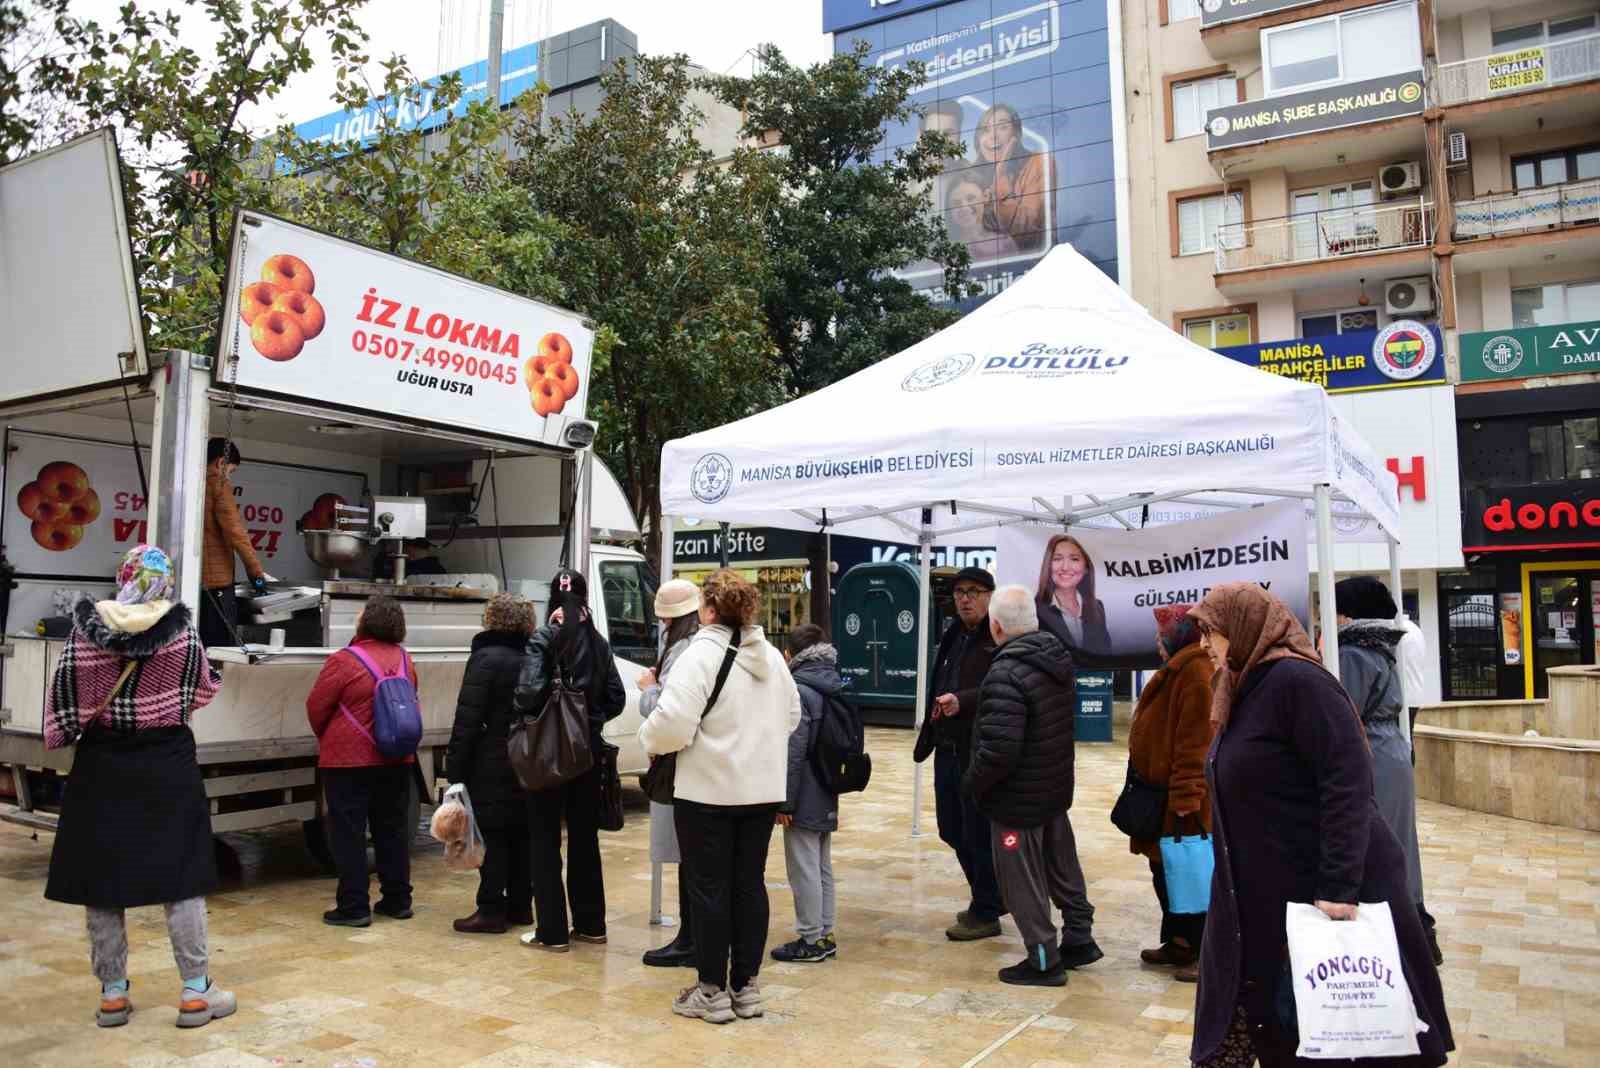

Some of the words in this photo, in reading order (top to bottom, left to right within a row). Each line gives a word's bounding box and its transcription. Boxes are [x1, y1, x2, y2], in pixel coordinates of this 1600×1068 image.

[998, 19, 1049, 58] iyisi
[1488, 58, 1542, 76] KIRALIK
[1233, 110, 1280, 131] MANİSA
[1283, 104, 1315, 125] ŞUBE
[1318, 88, 1396, 115] BAŞKANLIĞI
[356, 287, 401, 329] İZ
[404, 307, 520, 358] LOKMA
[984, 355, 1130, 370] DUTLULU
[1021, 342, 1104, 356] Besim
[1260, 343, 1324, 362] MANİSA
[397, 369, 438, 389] UĞUR
[440, 379, 474, 397] USTA
[740, 464, 792, 481] MANİSA
[795, 456, 883, 479] BÜYÜKŞEHİR
[888, 448, 973, 472] BELEDİYESİ
[997, 452, 1046, 466] SOSYAL
[1049, 447, 1124, 462] HİZMETLER
[1127, 440, 1182, 459] DAİRESİ
[1186, 434, 1275, 456] BAŞKANLIĞI
[713, 531, 765, 554] Köfte
[1104, 536, 1289, 578] KALBİMİZDESİN
[1305, 955, 1395, 990] YONCAGÜL
